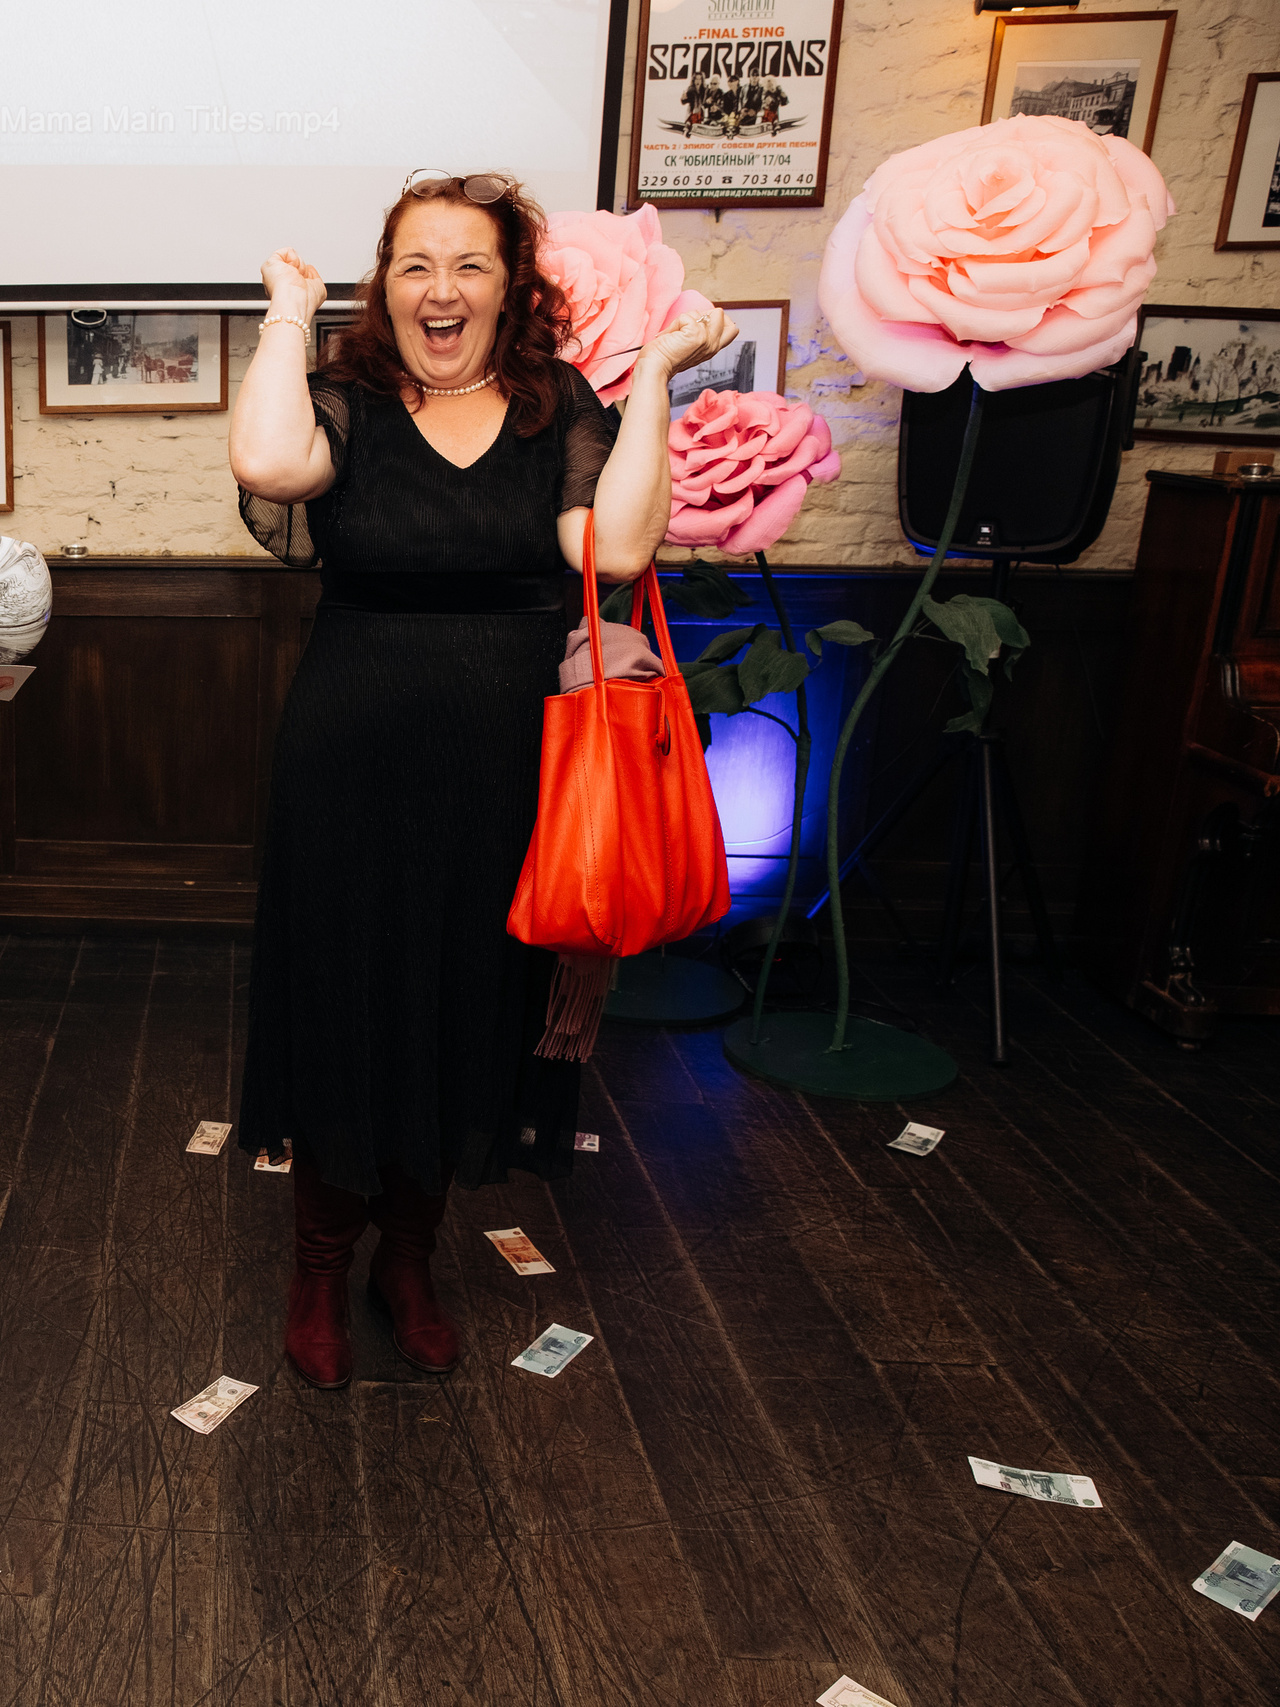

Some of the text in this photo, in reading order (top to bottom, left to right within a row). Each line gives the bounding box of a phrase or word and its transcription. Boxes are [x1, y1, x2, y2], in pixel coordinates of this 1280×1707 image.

[742, 26, 785, 38] STING
[649, 39, 826, 80] SCORPIONS
[102, 105, 176, 133] Main
[184, 105, 341, 139] Titles.mp4
[756, 141, 787, 149] ДРУГИЕ
[664, 155, 677, 167] СК
[762, 154, 791, 166] 17/04
[641, 173, 813, 186] 329 60 50 703 40 40
[640, 188, 812, 198] ПРИНИМАЮТСЯ ИНДИВИДУАЛЬНЫЕ ЗАКАЗЫ
